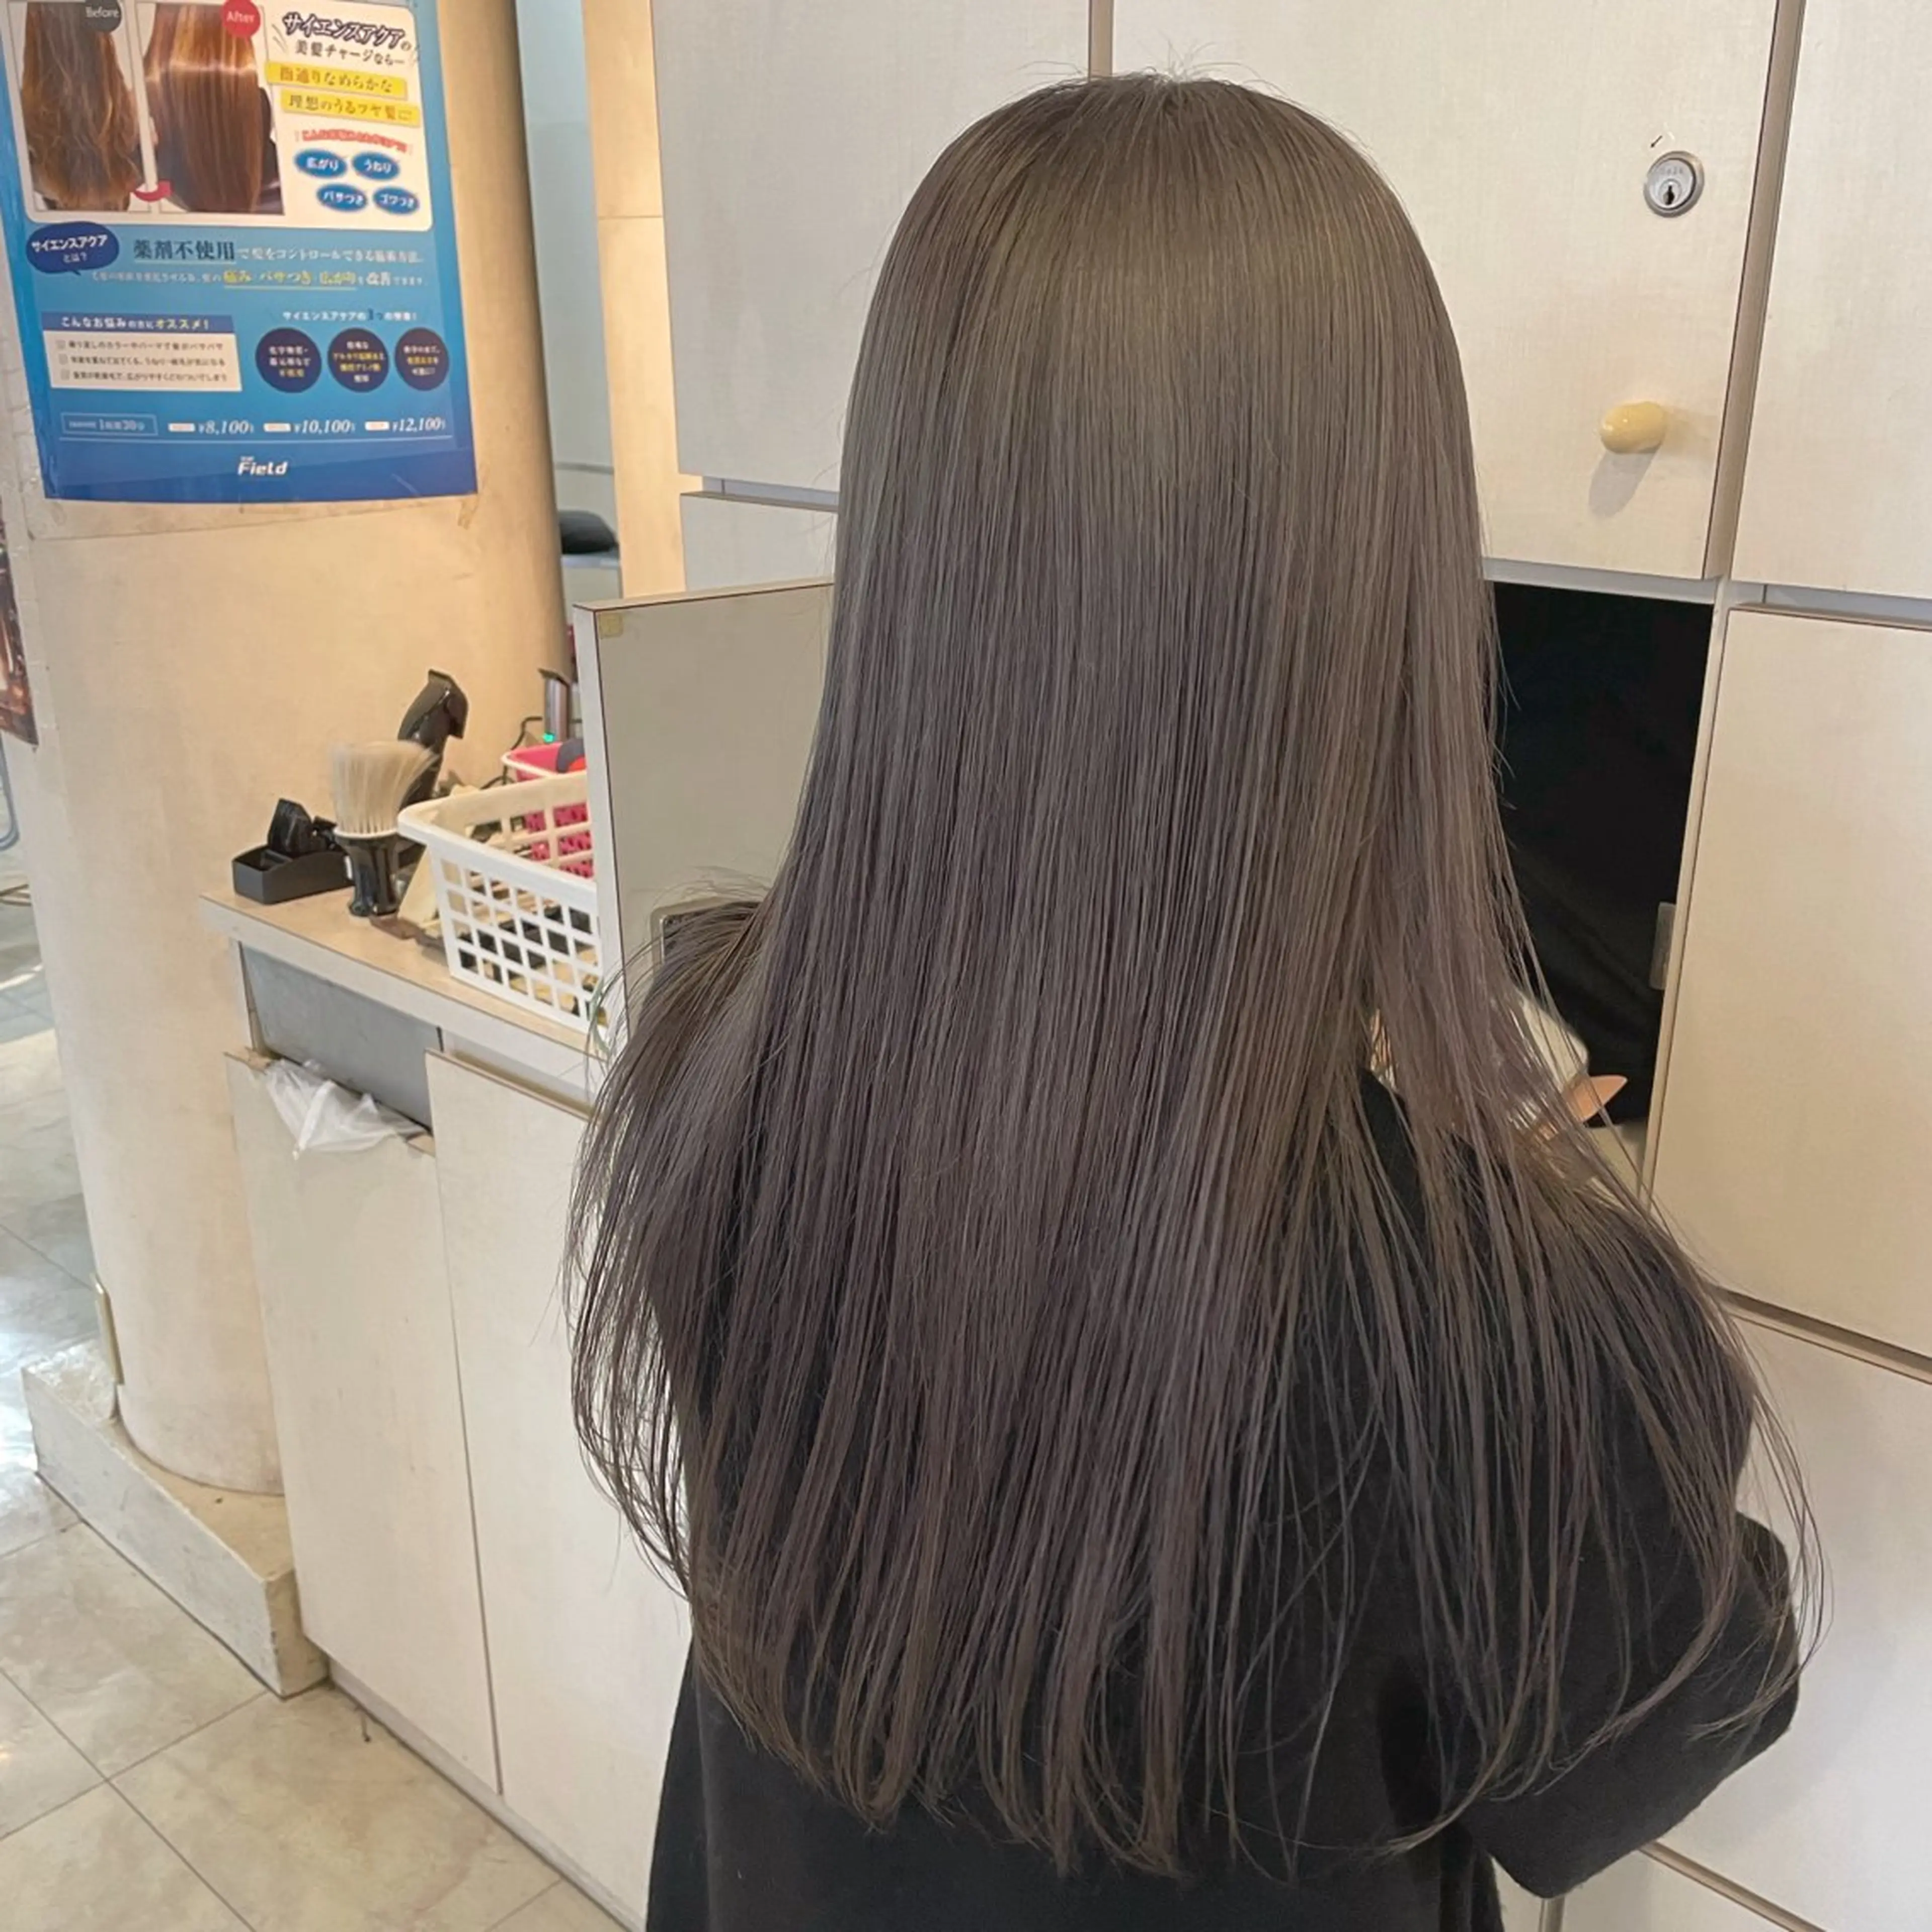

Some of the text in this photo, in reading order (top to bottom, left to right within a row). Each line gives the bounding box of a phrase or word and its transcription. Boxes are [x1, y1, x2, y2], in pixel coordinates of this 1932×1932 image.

[85, 6, 119, 18] Before
[226, 10, 255, 23] After
[364, 158, 391, 175] うねり
[31, 234, 108, 252] サイエンスアクア
[237, 461, 288, 475] Field
